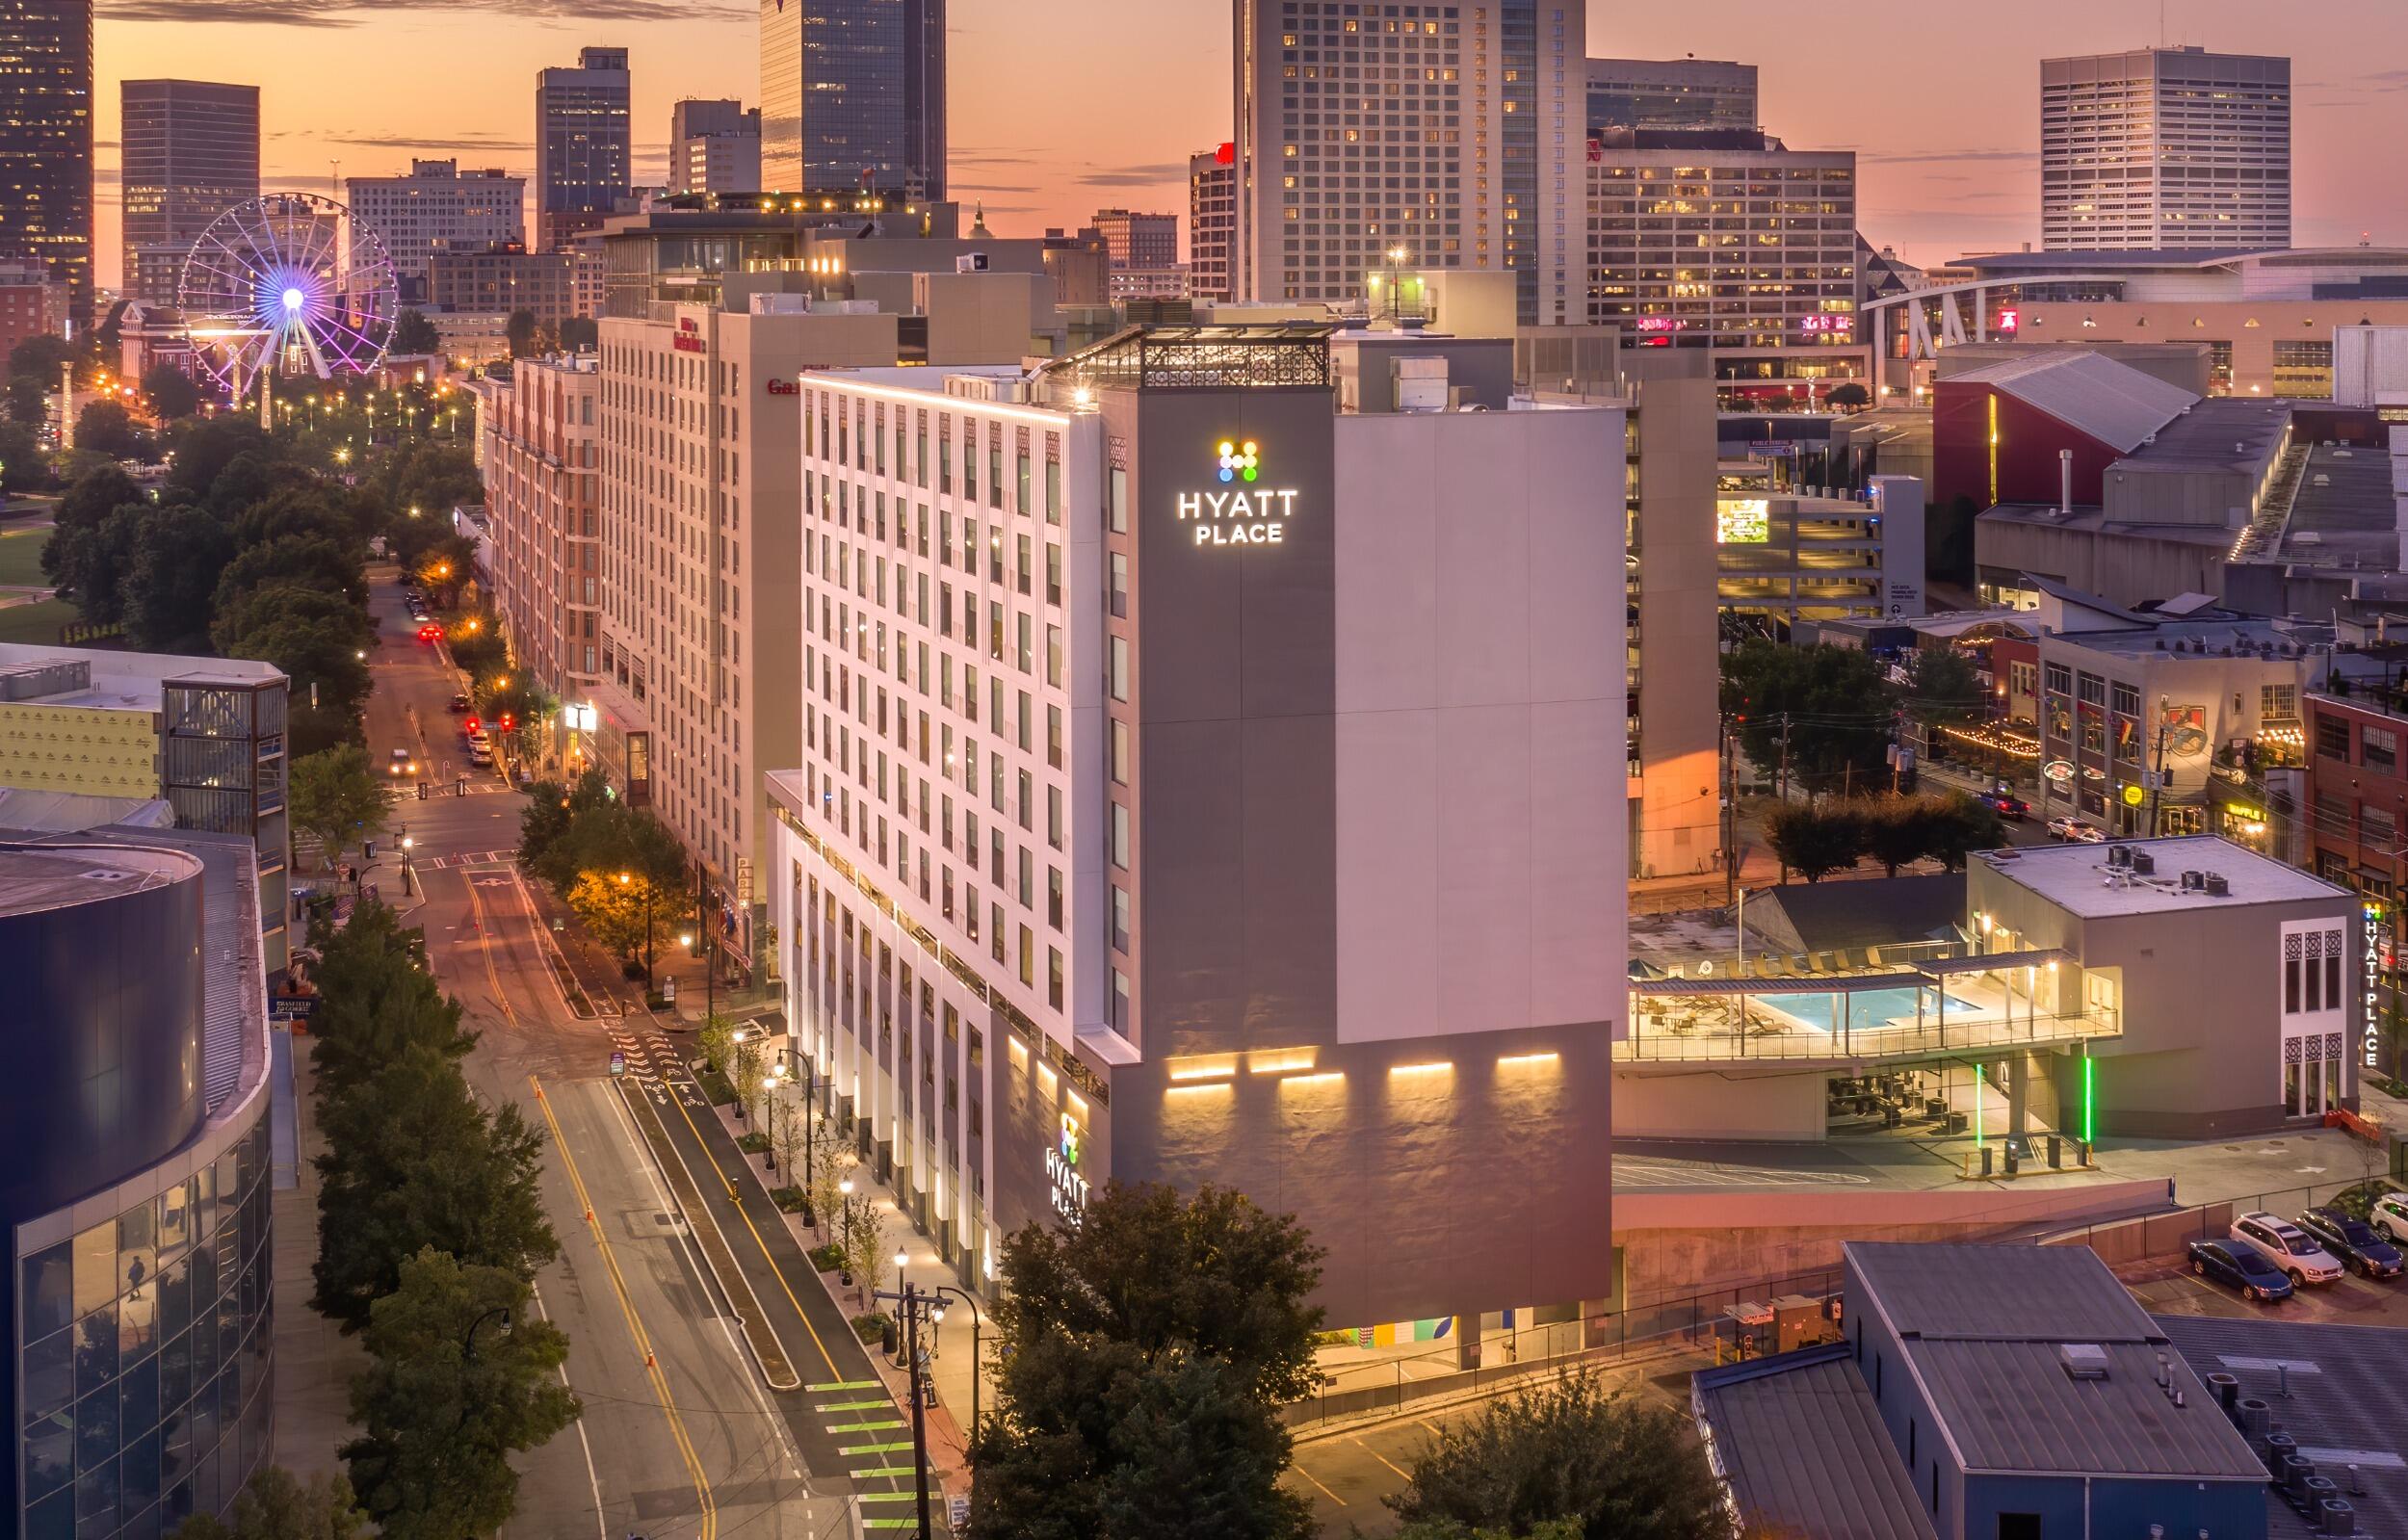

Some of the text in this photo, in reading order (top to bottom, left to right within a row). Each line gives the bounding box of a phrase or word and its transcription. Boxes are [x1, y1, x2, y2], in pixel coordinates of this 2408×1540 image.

[1178, 489, 1298, 519] HYATT
[1195, 523, 1283, 545] PLACE
[739, 859, 747, 897] PARK
[2365, 922, 2378, 1066] HYATT PLACE
[1046, 1147, 1091, 1210] HYATT
